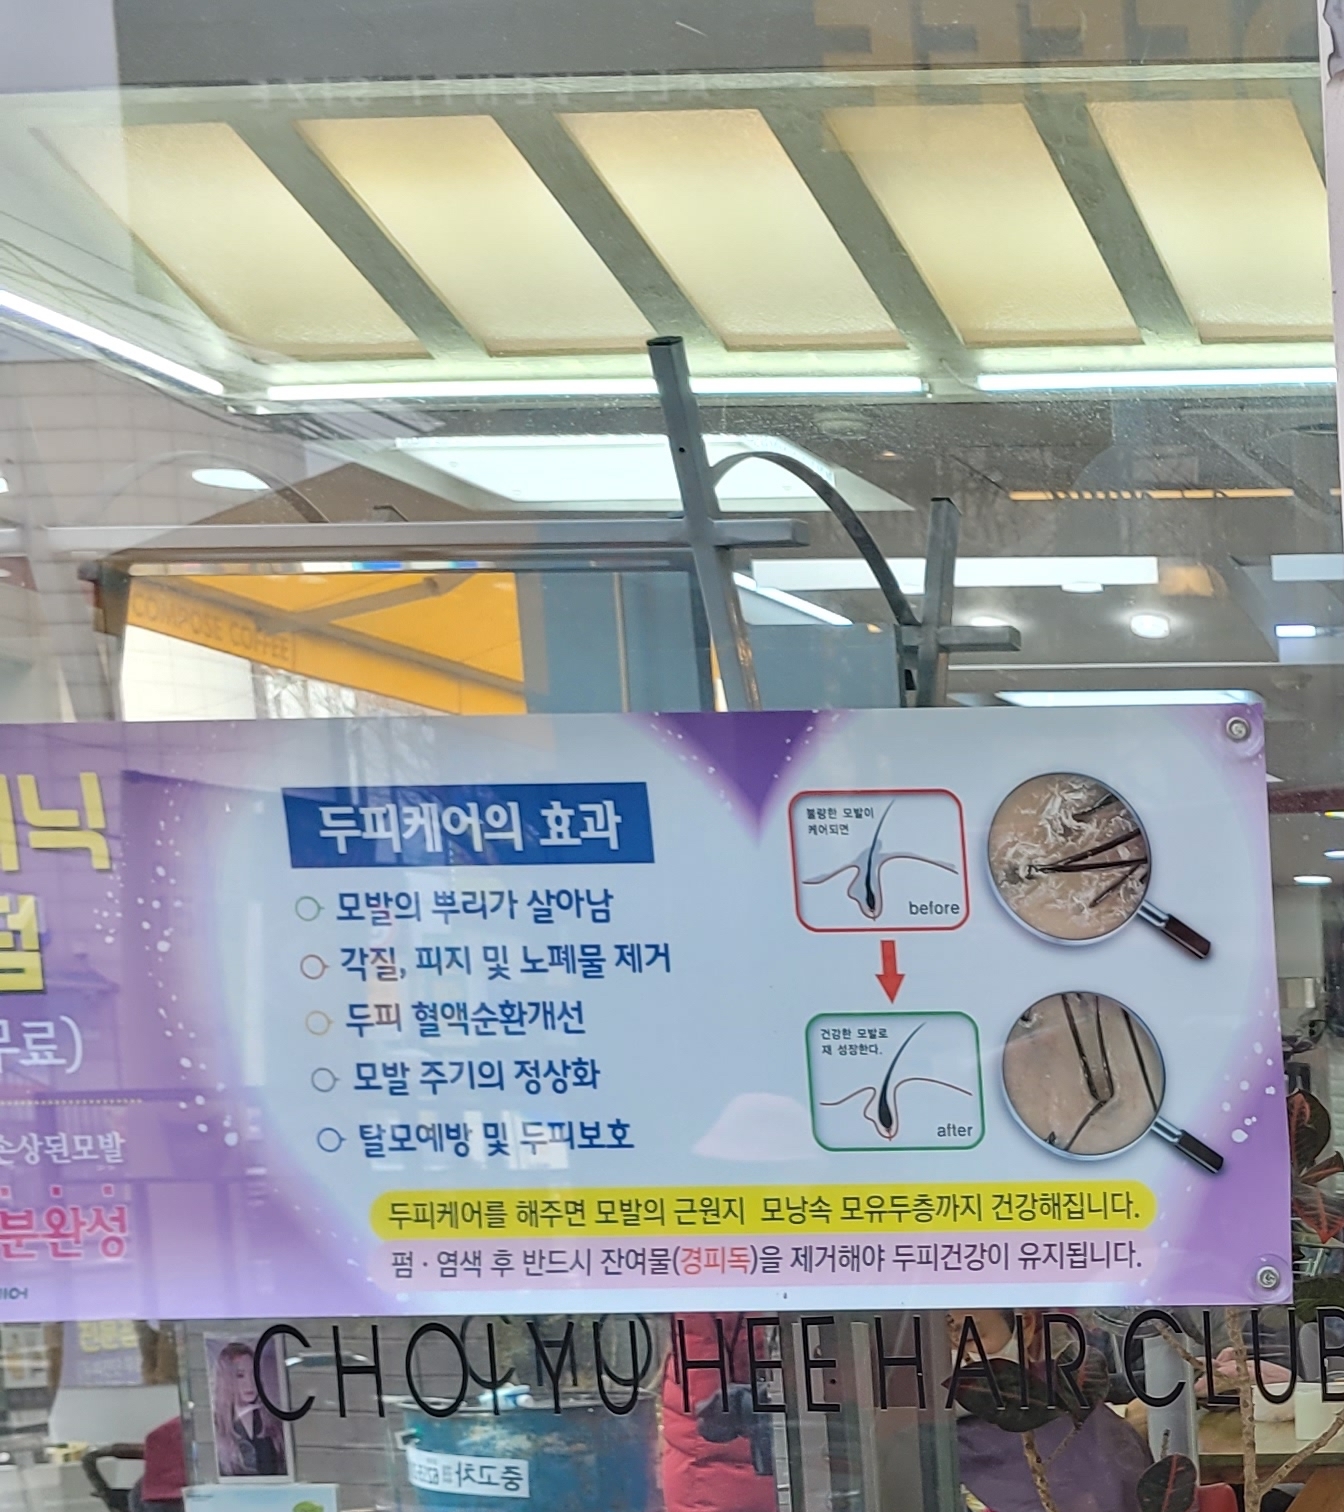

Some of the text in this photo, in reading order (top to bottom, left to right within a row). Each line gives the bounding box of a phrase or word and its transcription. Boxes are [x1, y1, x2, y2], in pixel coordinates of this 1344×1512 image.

[319, 799, 622, 855] 두피케어의 효과
[842, 806, 874, 819] 모발이
[336, 888, 615, 926] 모발의 뿌리가 살아남
[909, 901, 960, 915] before
[340, 941, 672, 982] 각질, 피지 및 노폐물 제거
[345, 1000, 587, 1039] 두피 혈액순환개선
[820, 1027, 888, 1040] 건강한 모발로
[353, 1056, 601, 1097] 모발 주기의 정상화
[358, 1117, 635, 1159] 탈모예방 및 두피보호
[937, 1123, 973, 1138] after
[388, 1191, 1141, 1231] 두피케어를 해주면 모발의 근원지 모낭속 모유두층까지 건강해집니다.
[392, 1239, 1143, 1279] 펌 염색 후 반드시 잔여물(경피독)을 제거해야 두피건강이 유지됩니다.
[253, 1321, 501, 1421] CHOI
[526, 1320, 641, 1416] YU
[677, 1313, 841, 1416] HEE
[873, 1312, 1091, 1411] HAIR
